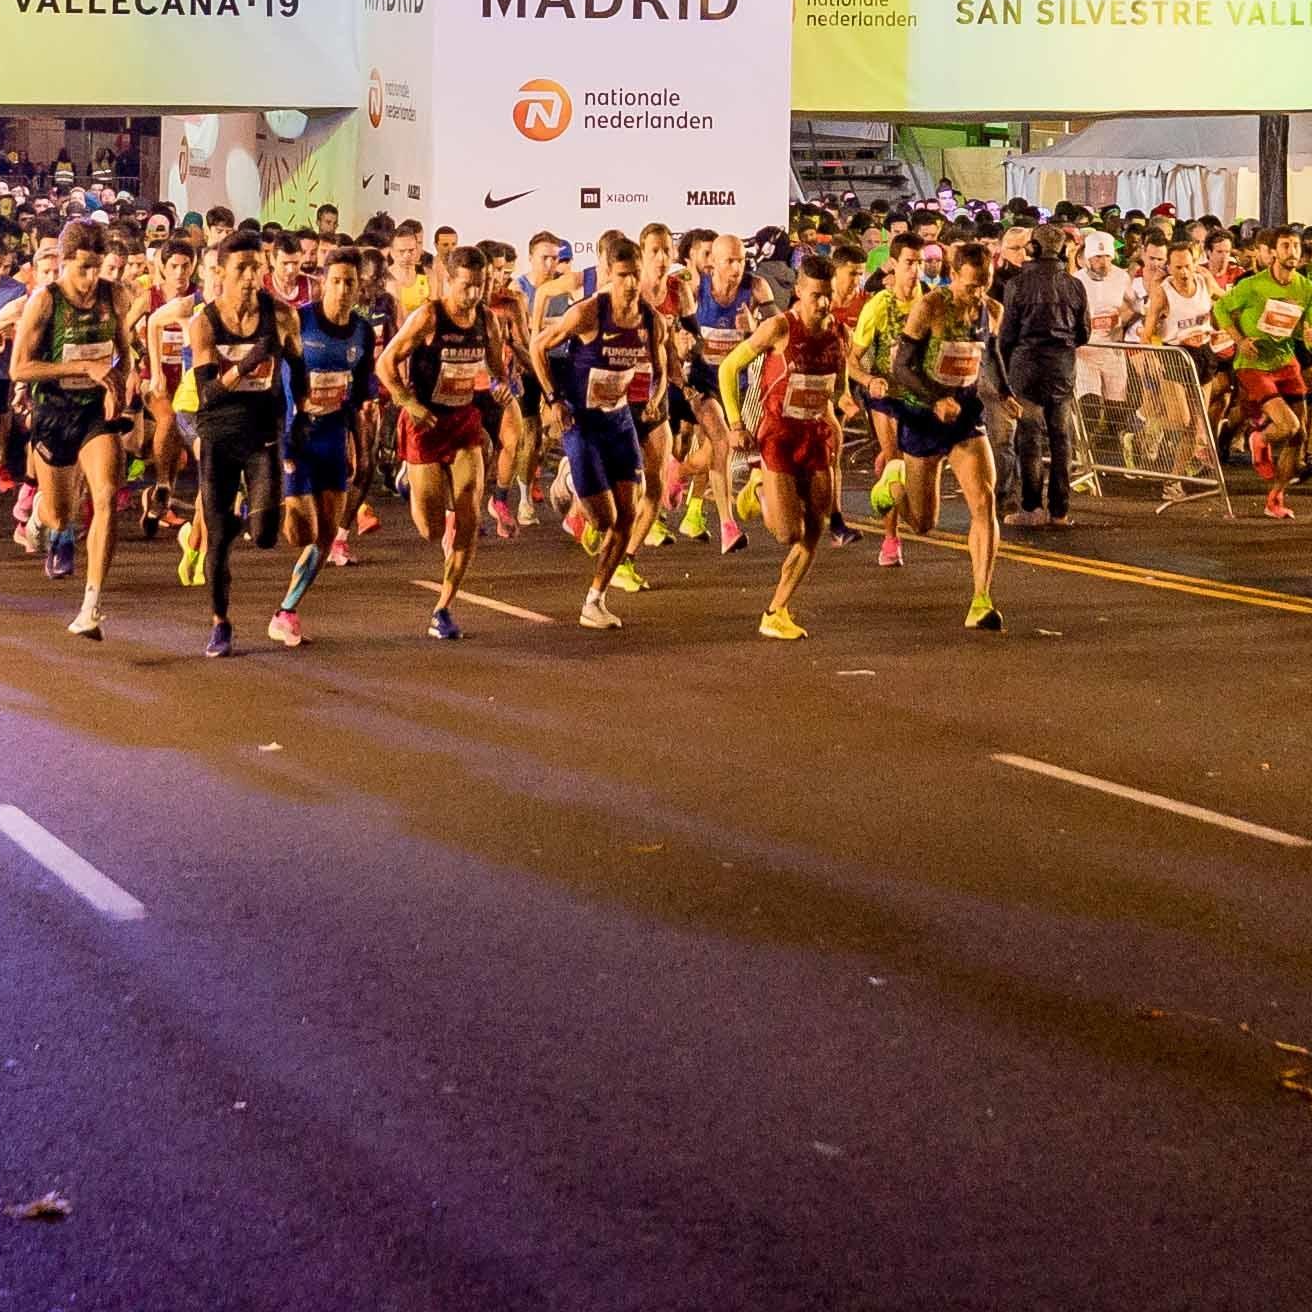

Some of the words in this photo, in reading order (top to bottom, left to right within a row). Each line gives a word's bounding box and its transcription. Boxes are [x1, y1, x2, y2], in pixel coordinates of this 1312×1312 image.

[806, 10, 917, 27] nederlanden
[955, 0, 1022, 26] SAN
[1036, 0, 1212, 26] SILVESTRE
[583, 87, 681, 107] nationale
[583, 110, 713, 130] nederlanden
[606, 191, 649, 203] xiaomi
[686, 190, 736, 206] MARCA
